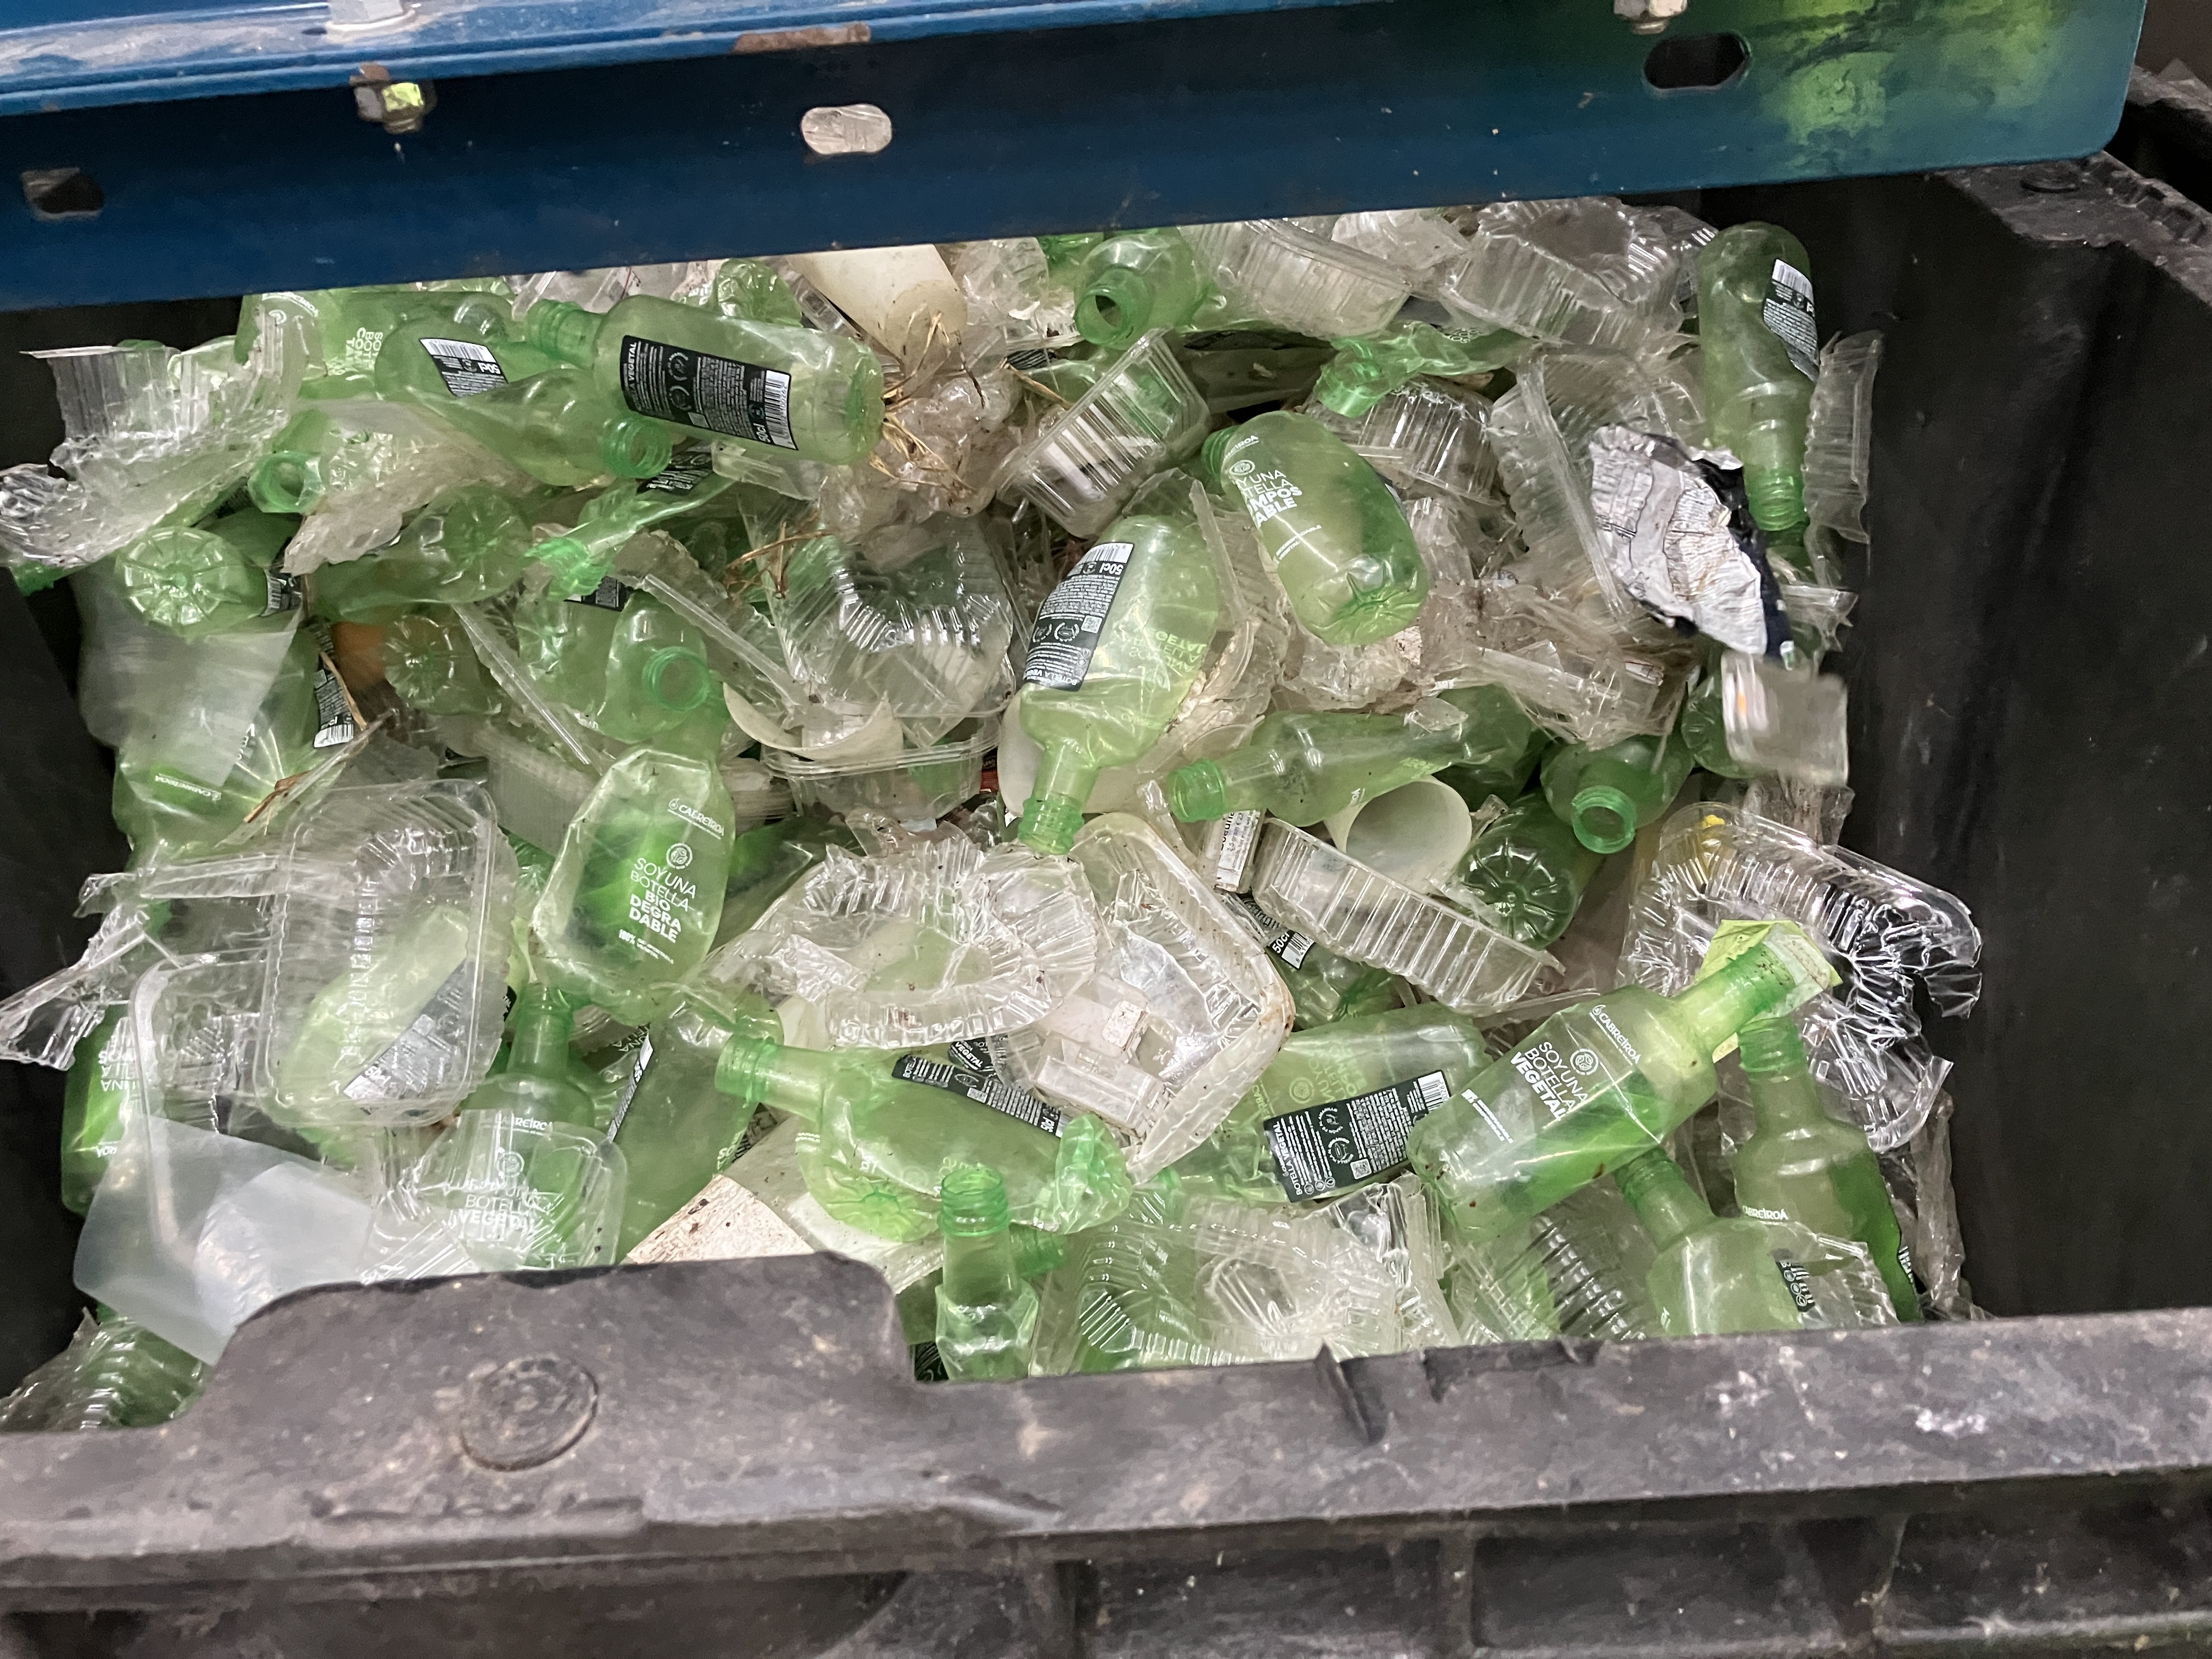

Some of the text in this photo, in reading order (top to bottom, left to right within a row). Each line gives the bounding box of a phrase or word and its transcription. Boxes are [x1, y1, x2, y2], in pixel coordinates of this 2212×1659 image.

[477, 362, 501, 374] 50cl
[628, 342, 637, 381] VEGETAL
[1255, 497, 1297, 528] ABLE
[1099, 562, 1124, 575] 50cl
[630, 870, 689, 912] BOTELLA
[634, 857, 697, 899] SOY UNA
[630, 893, 682, 932] DEGRA
[645, 889, 671, 912] BIO
[629, 906, 679, 944] DABLE
[1272, 932, 1290, 953] 50cl
[955, 1041, 984, 1068] VEGETAL
[1539, 1041, 1588, 1103] SOY UNA
[1510, 1051, 1566, 1121] VEGETAL
[1524, 1047, 1576, 1111] BOTELLA
[1273, 1121, 1303, 1196] BOTELLA VEGETAL
